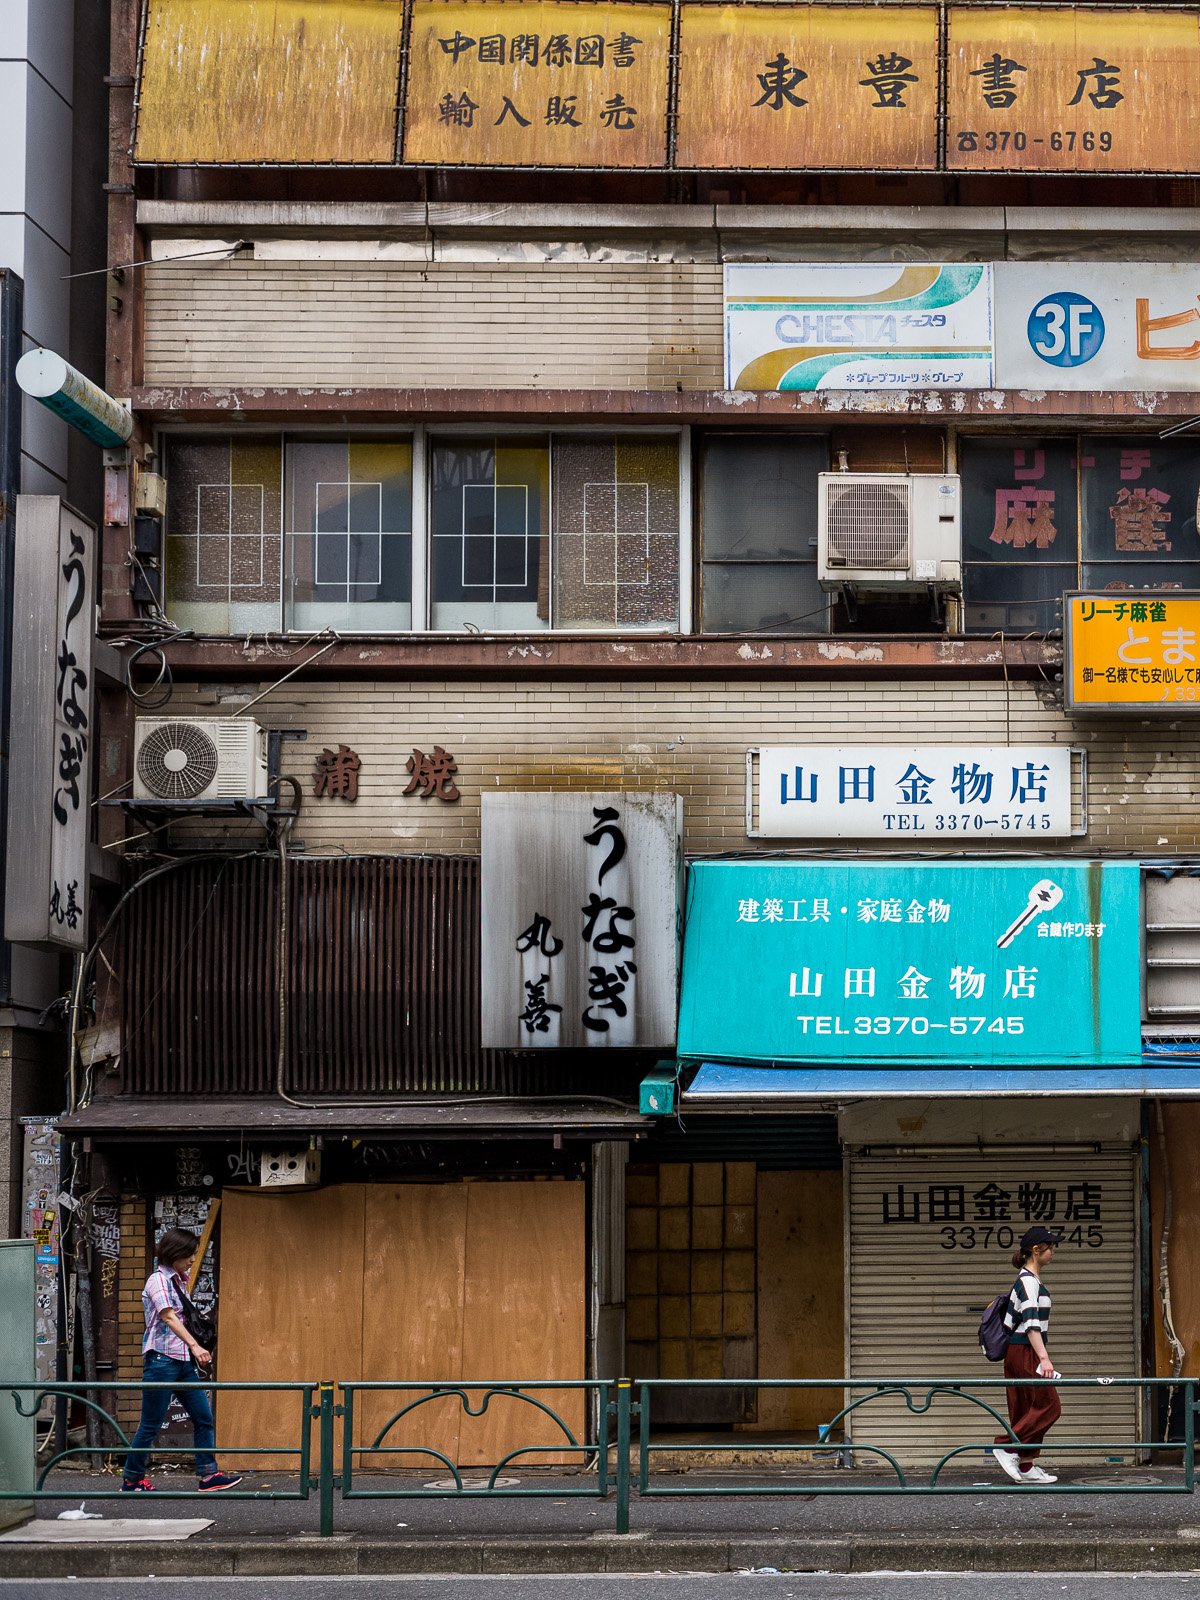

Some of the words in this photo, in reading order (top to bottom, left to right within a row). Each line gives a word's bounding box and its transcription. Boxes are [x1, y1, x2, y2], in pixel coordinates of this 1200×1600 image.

[438, 30, 643, 69] 中国関係図書
[751, 51, 1125, 110] 東豊書店
[438, 92, 638, 130] 輸入販売
[985, 130, 1113, 152] 370-6769
[775, 314, 897, 344] CHESTA
[900, 314, 947, 328] チェスタ
[1035, 301, 1094, 358] 3F
[989, 486, 1172, 552] 麻雀
[1081, 602, 1167, 623] リーチ麻雀
[54, 528, 88, 827] うなぎ
[312, 744, 460, 800] 蒲焼
[779, 762, 1051, 805] 山田金物店
[882, 813, 925, 831] TEL
[935, 813, 1052, 832] 3370-5745
[49, 880, 83, 930] 丸善
[582, 806, 637, 1032] うなぎ
[737, 898, 951, 925] 建築工具・家庭金物
[1036, 921, 1107, 938] 合鍵作ります
[516, 912, 563, 1032] 丸善
[789, 965, 1039, 1000] 山田金物店
[883, 1182, 1101, 1224] 山田金物店
